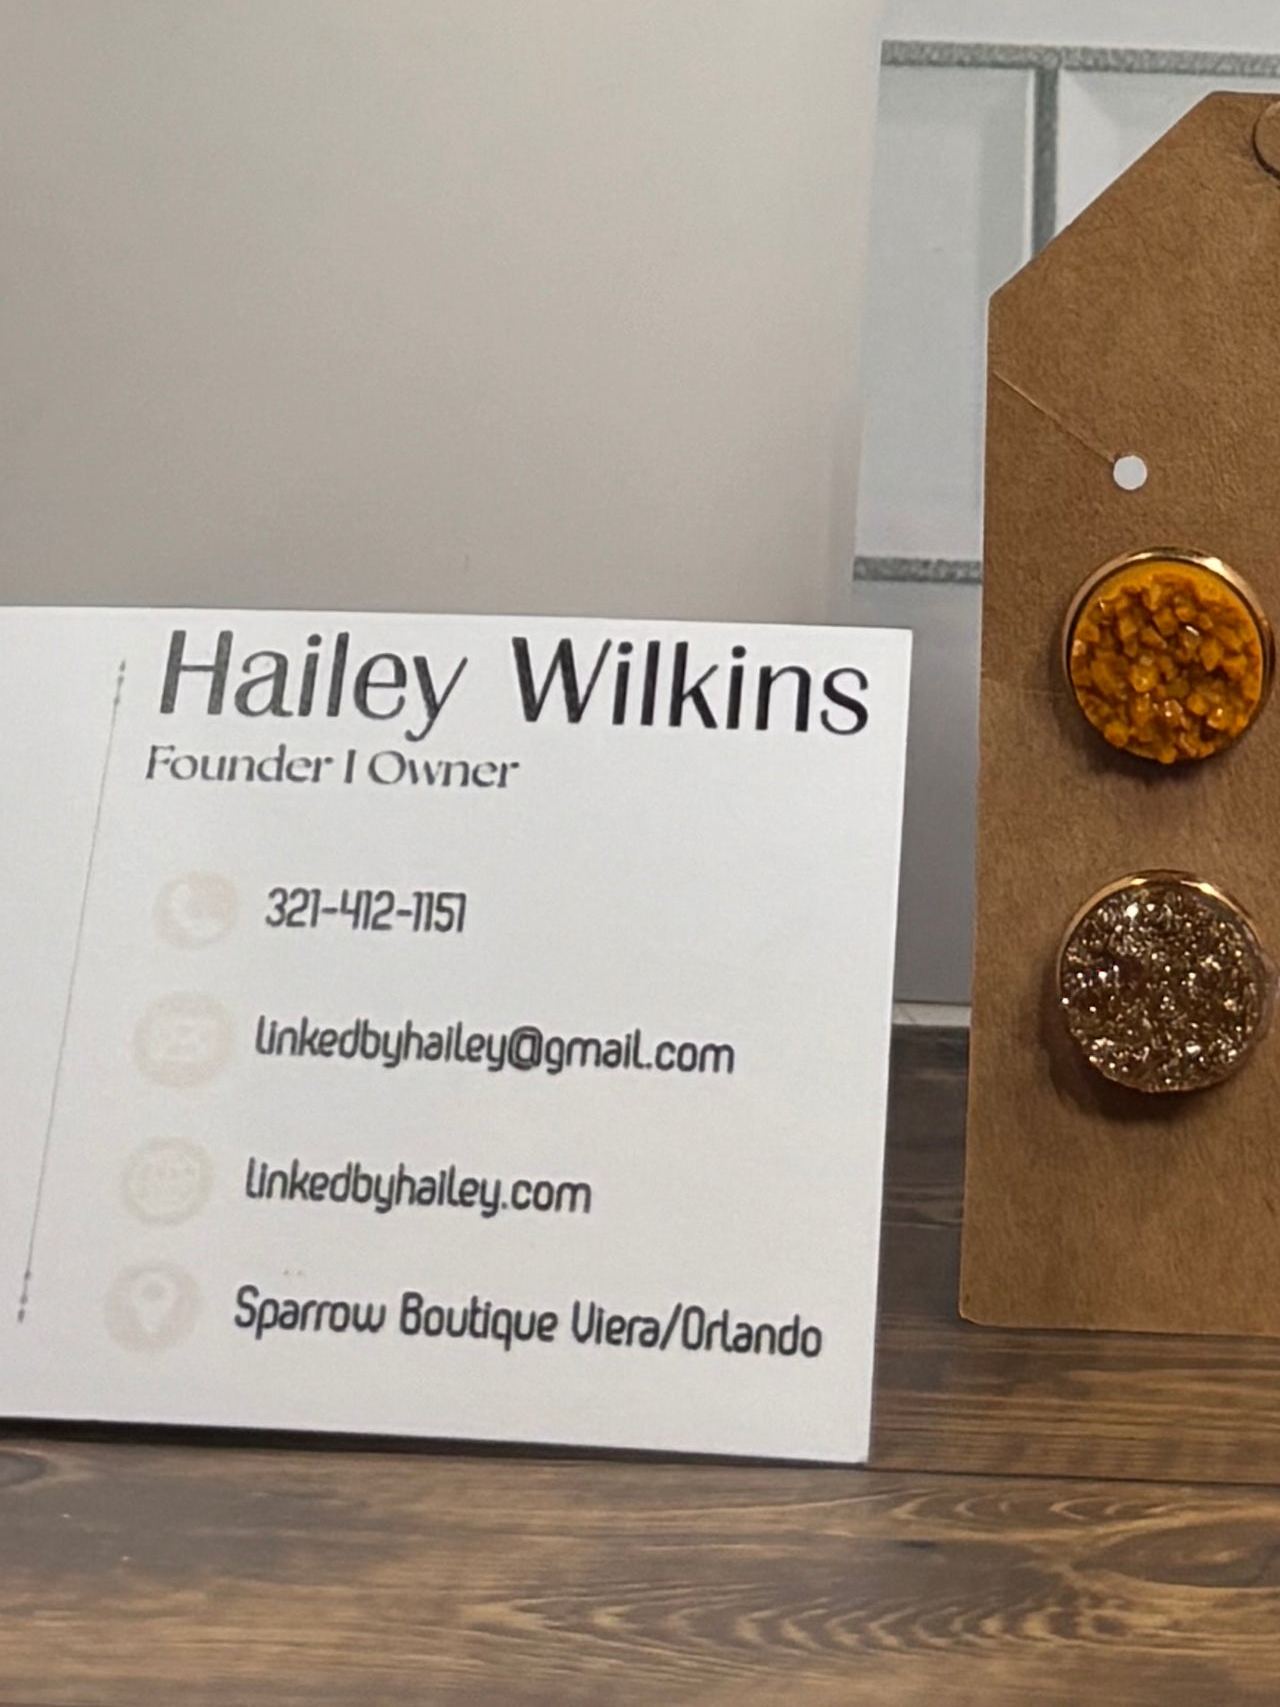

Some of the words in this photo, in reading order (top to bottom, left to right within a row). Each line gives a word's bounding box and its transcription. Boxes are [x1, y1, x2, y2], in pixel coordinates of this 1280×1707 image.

[157, 628, 469, 743] Hailey
[510, 635, 870, 736] Wilkins
[144, 744, 333, 785] Founder
[366, 749, 521, 789] Owner
[264, 887, 468, 934] 321-412-1151
[254, 1015, 735, 1075] linkedbyhailey@gmail.com
[244, 1157, 593, 1217] linkedbyhailey.com
[232, 1285, 387, 1339] Sparrow
[399, 1292, 559, 1351] Boutique
[571, 1304, 823, 1359] Viera/Orlando
